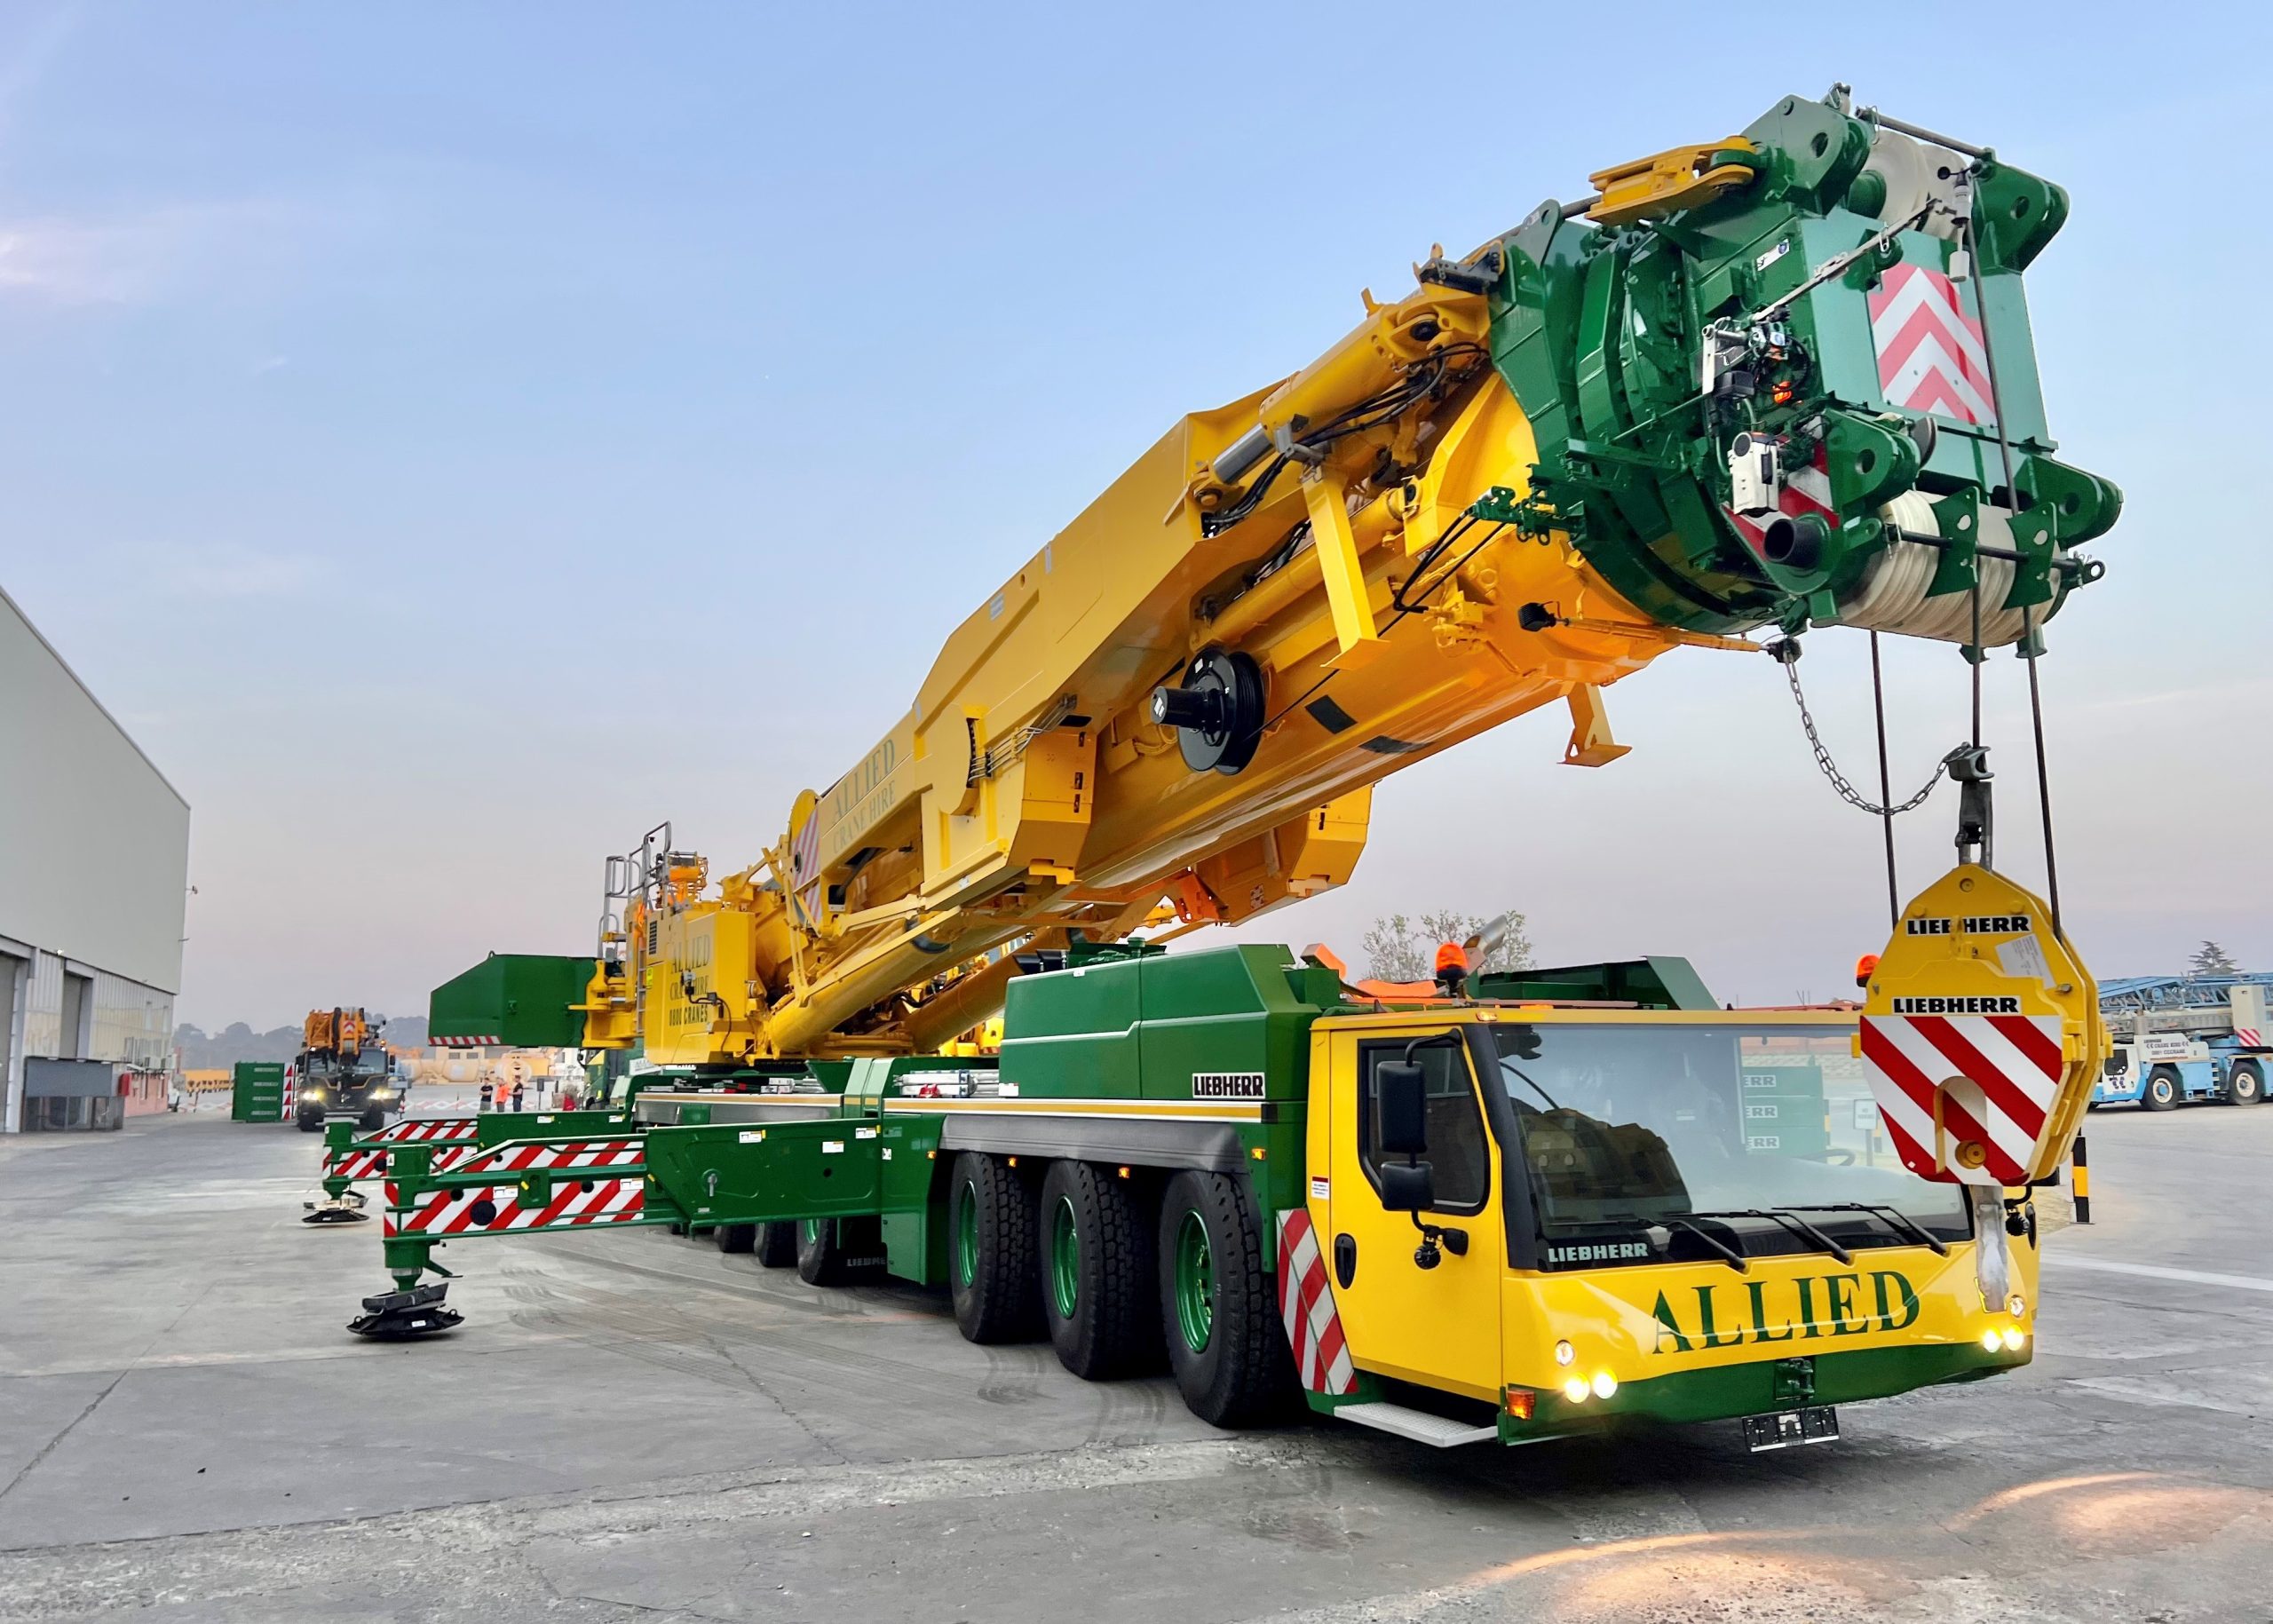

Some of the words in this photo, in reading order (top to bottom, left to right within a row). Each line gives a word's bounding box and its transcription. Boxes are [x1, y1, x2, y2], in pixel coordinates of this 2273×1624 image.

[832, 739, 895, 823] ALLIED
[833, 806, 867, 854] CRANE
[869, 780, 896, 824] HIRE
[670, 934, 710, 974] ALLIED
[684, 1003, 708, 1025] CRANES
[1893, 997, 2018, 1013] LIEBHERR
[1194, 1075, 1263, 1097] LIEBHERR
[1548, 1243, 1649, 1262] LIEBHERR
[1651, 1271, 1920, 1355] ALLIED
